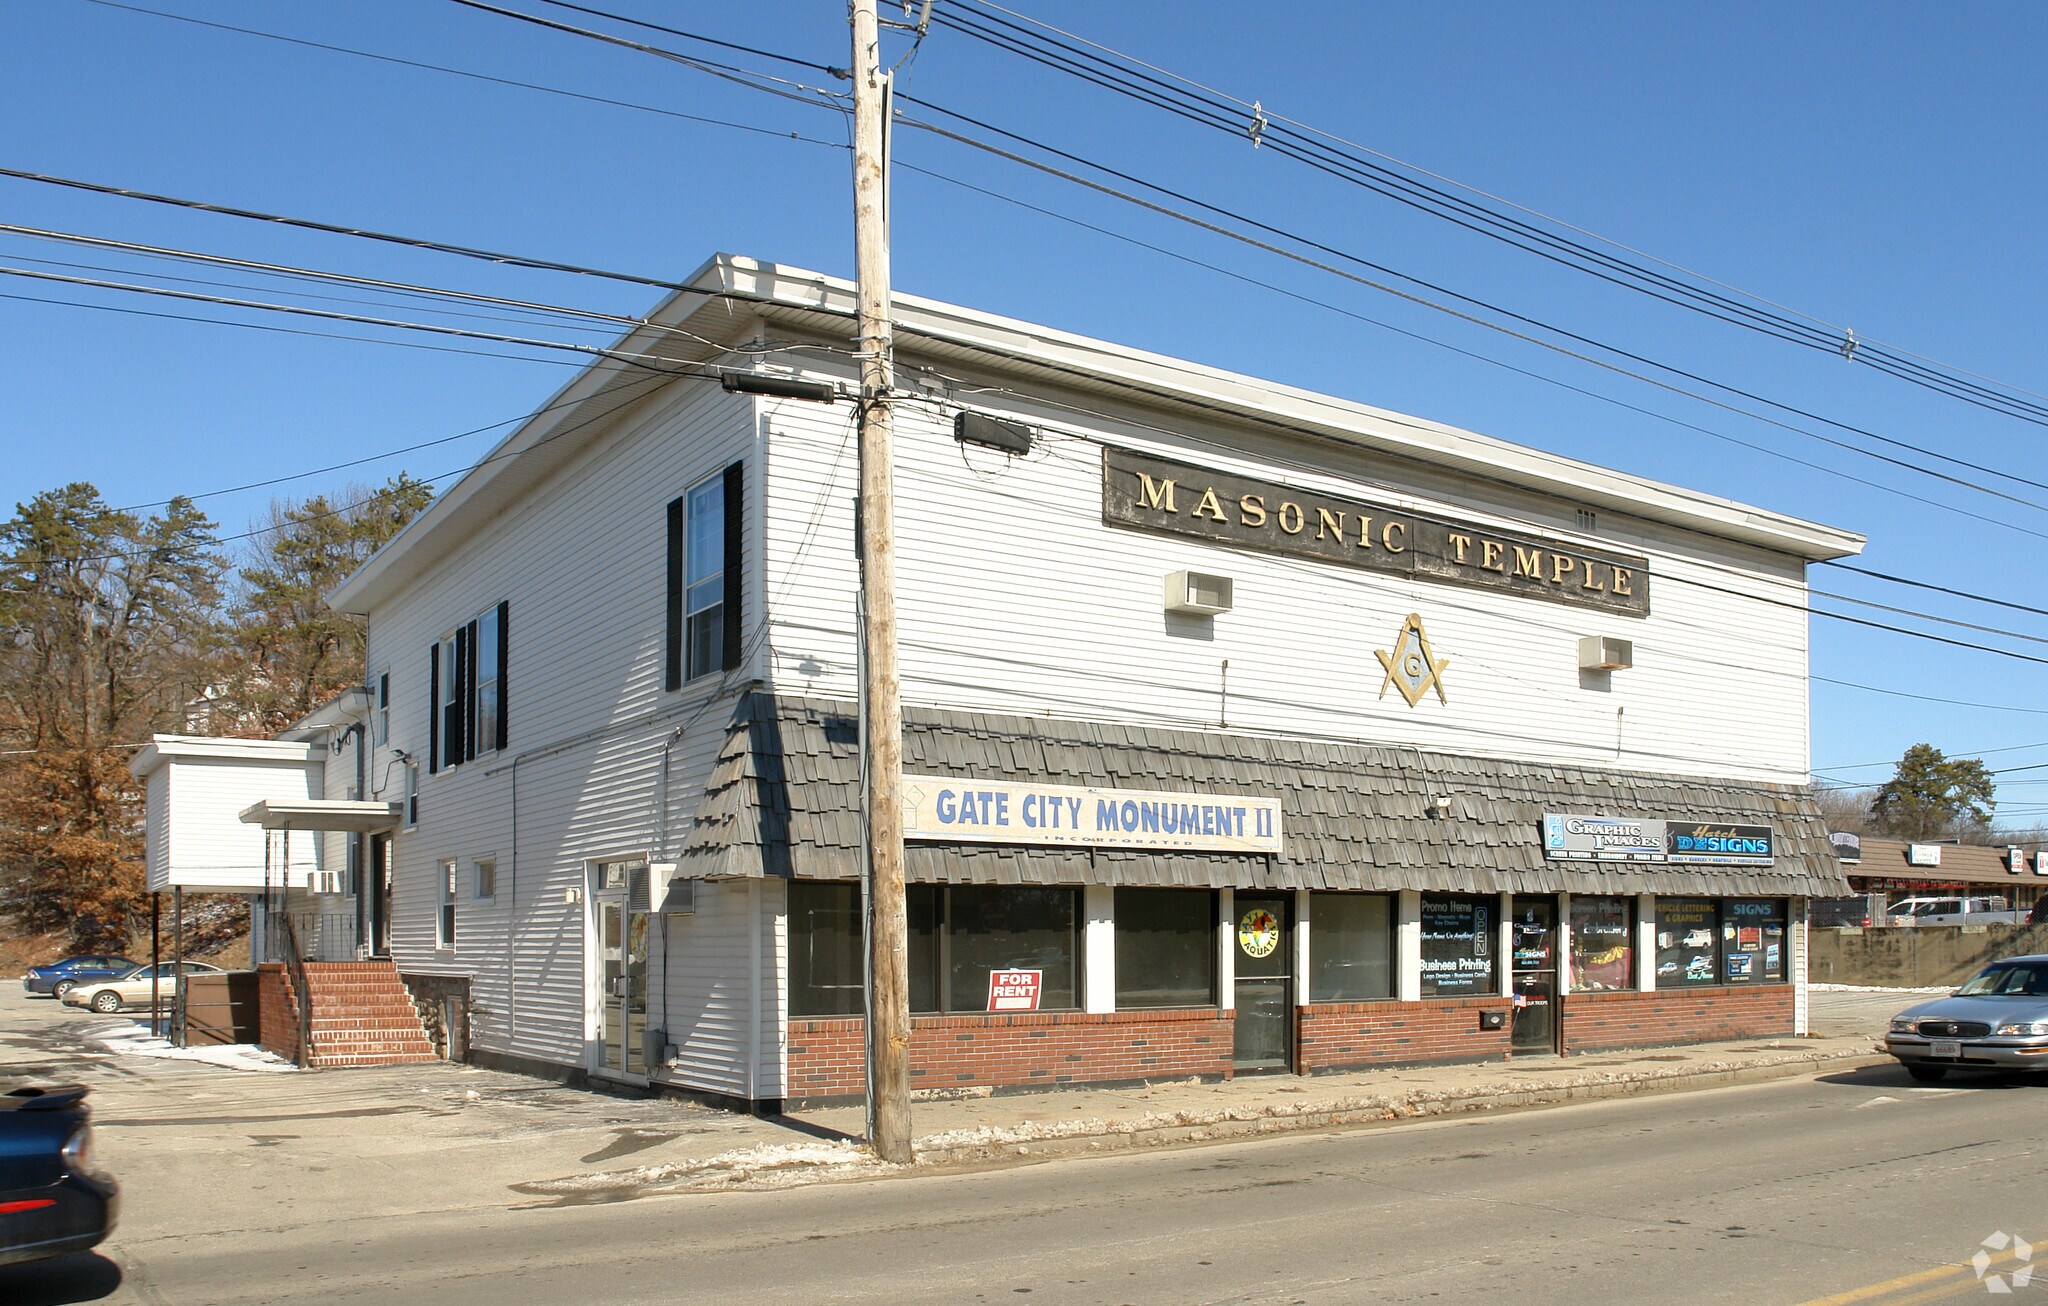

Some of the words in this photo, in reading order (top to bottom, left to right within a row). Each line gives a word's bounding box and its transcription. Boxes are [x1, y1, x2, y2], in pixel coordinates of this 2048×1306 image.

[1134, 472, 1406, 553] MASONIC
[1447, 533, 1634, 597] TEMPLE
[936, 788, 1010, 826] GATE
[1022, 793, 1082, 830] CITY
[1096, 799, 1246, 837] MONUMENT
[1254, 807, 1273, 837] II
[1565, 818, 1641, 836] GRAPHIC
[1691, 825, 1737, 839] Hatch
[1044, 835, 1192, 846] INCORPORATED
[1593, 834, 1661, 850] IMAGES
[1676, 836, 1769, 853] DESIGNS
[1421, 900, 1447, 912] Promo
[1450, 900, 1472, 912] Items
[1733, 904, 1772, 915] SIGNS
[1476, 909, 1486, 953] OPEN
[1583, 922, 1628, 937] Embroidery
[1420, 958, 1457, 971] Business
[1459, 957, 1492, 973] Printing
[999, 973, 1033, 986] FOR
[993, 985, 1038, 997] RENT
